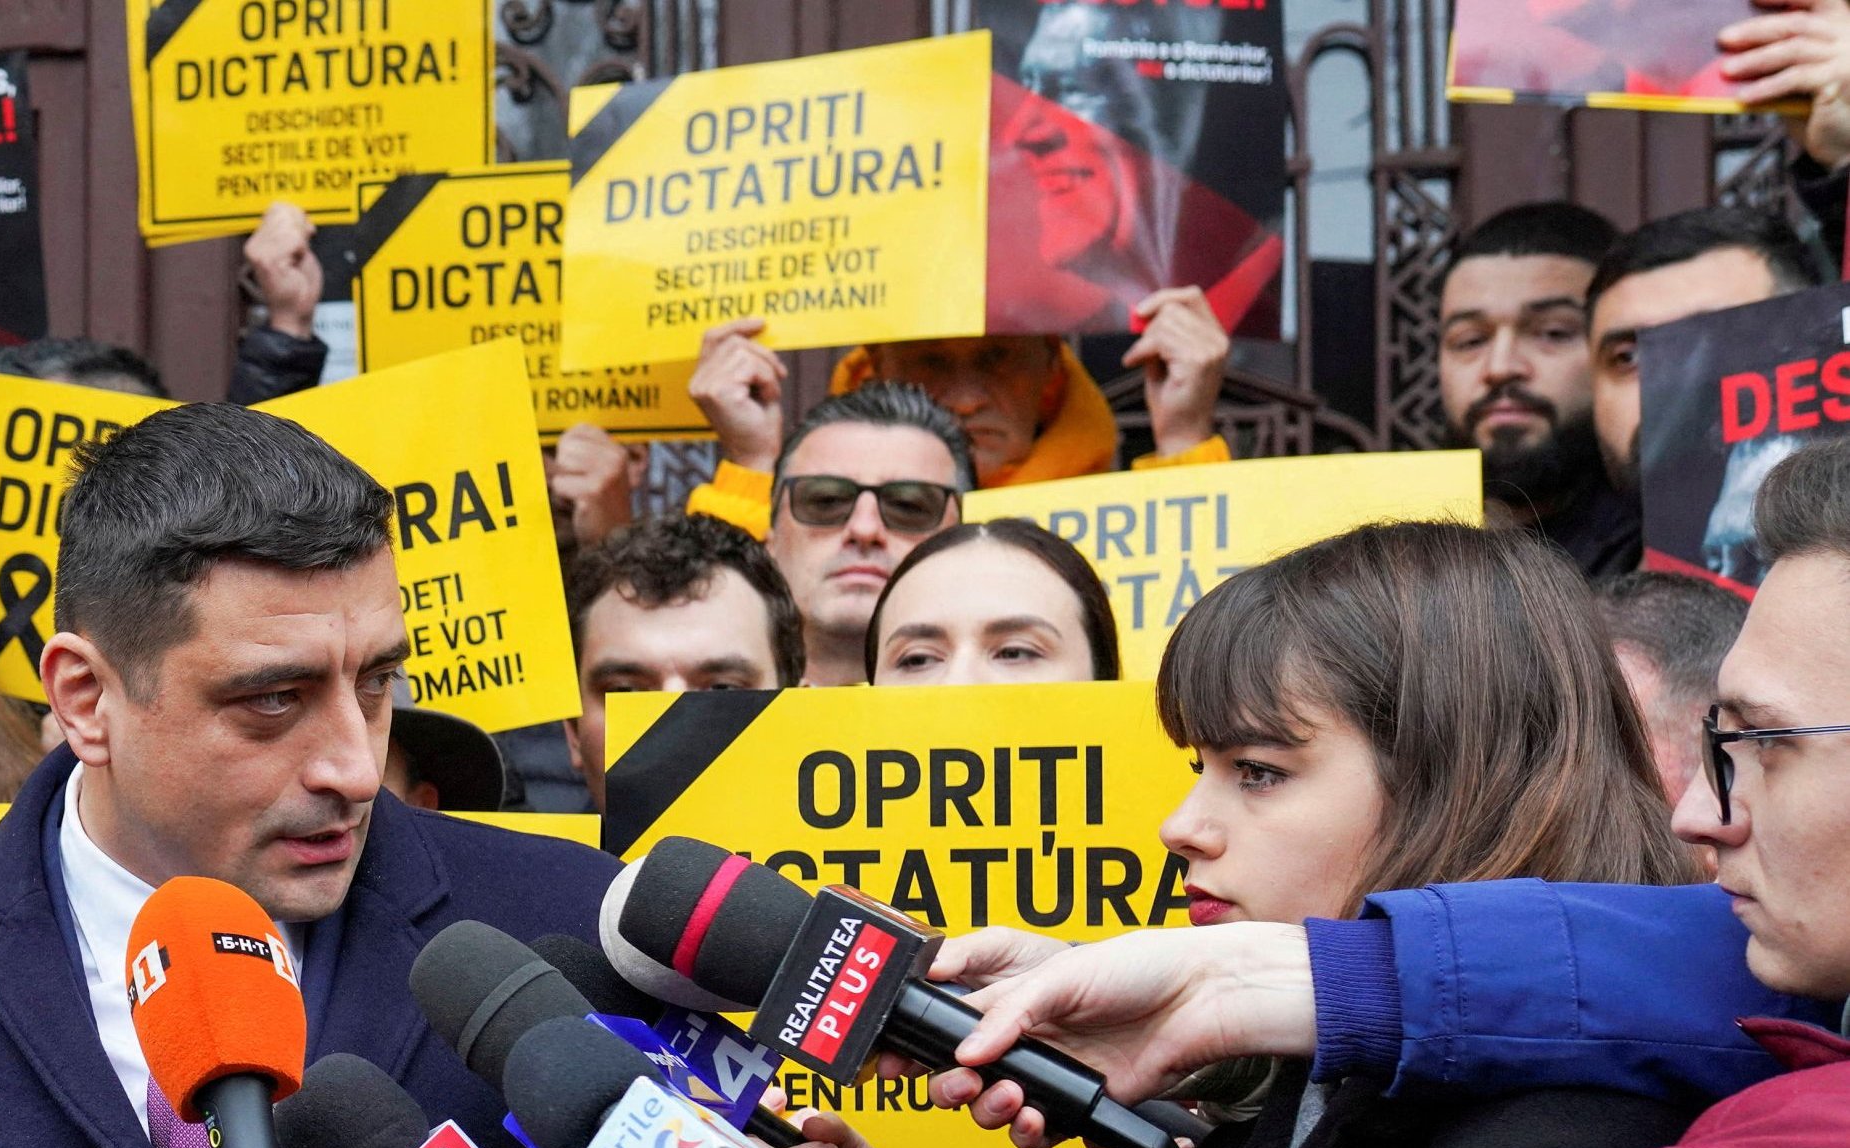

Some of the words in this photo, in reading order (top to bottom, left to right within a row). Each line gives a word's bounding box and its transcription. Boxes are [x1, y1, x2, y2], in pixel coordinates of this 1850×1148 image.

[176, 39, 457, 101] DICTATURA!
[325, 137, 353, 158] DE
[362, 133, 412, 156] VOT
[684, 90, 866, 154] OPRIȚI
[216, 168, 306, 198] PENTRU
[604, 140, 943, 224] DICTATURA!
[461, 200, 564, 249] OPR
[686, 215, 850, 255] DESCHIDEȚI
[655, 256, 771, 294] SECȚIILE
[780, 252, 814, 280] DE
[824, 247, 881, 275] VOT
[647, 292, 754, 328] PENTRU
[764, 280, 887, 315] ROMÂNI!
[1047, 494, 1229, 566] PRIȚI
[439, 609, 507, 650] VOT
[407, 652, 526, 705] OMÂNI!
[797, 745, 1105, 850] OPRIȚI
[778, 917, 863, 1047] REALITATEA
[816, 947, 881, 1040] PLUS
